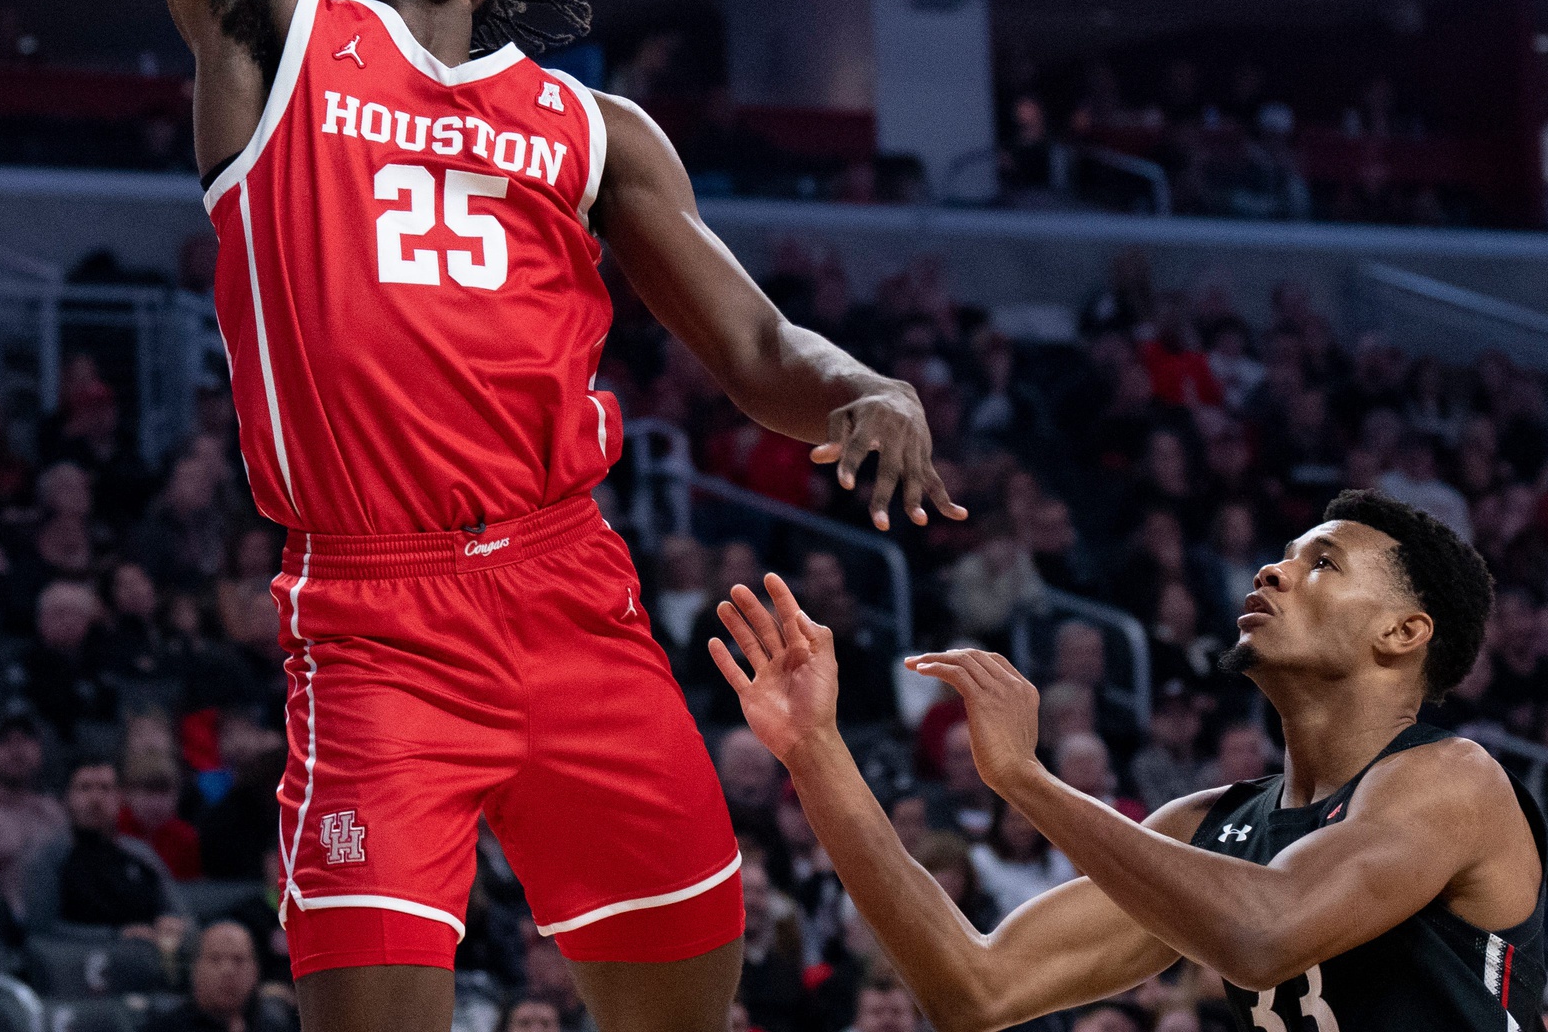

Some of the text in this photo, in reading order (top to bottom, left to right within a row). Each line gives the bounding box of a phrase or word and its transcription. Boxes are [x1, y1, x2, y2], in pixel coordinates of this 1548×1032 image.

[322, 91, 567, 186] HOUSTON
[374, 164, 509, 291] 25
[464, 537, 510, 557] Cougars
